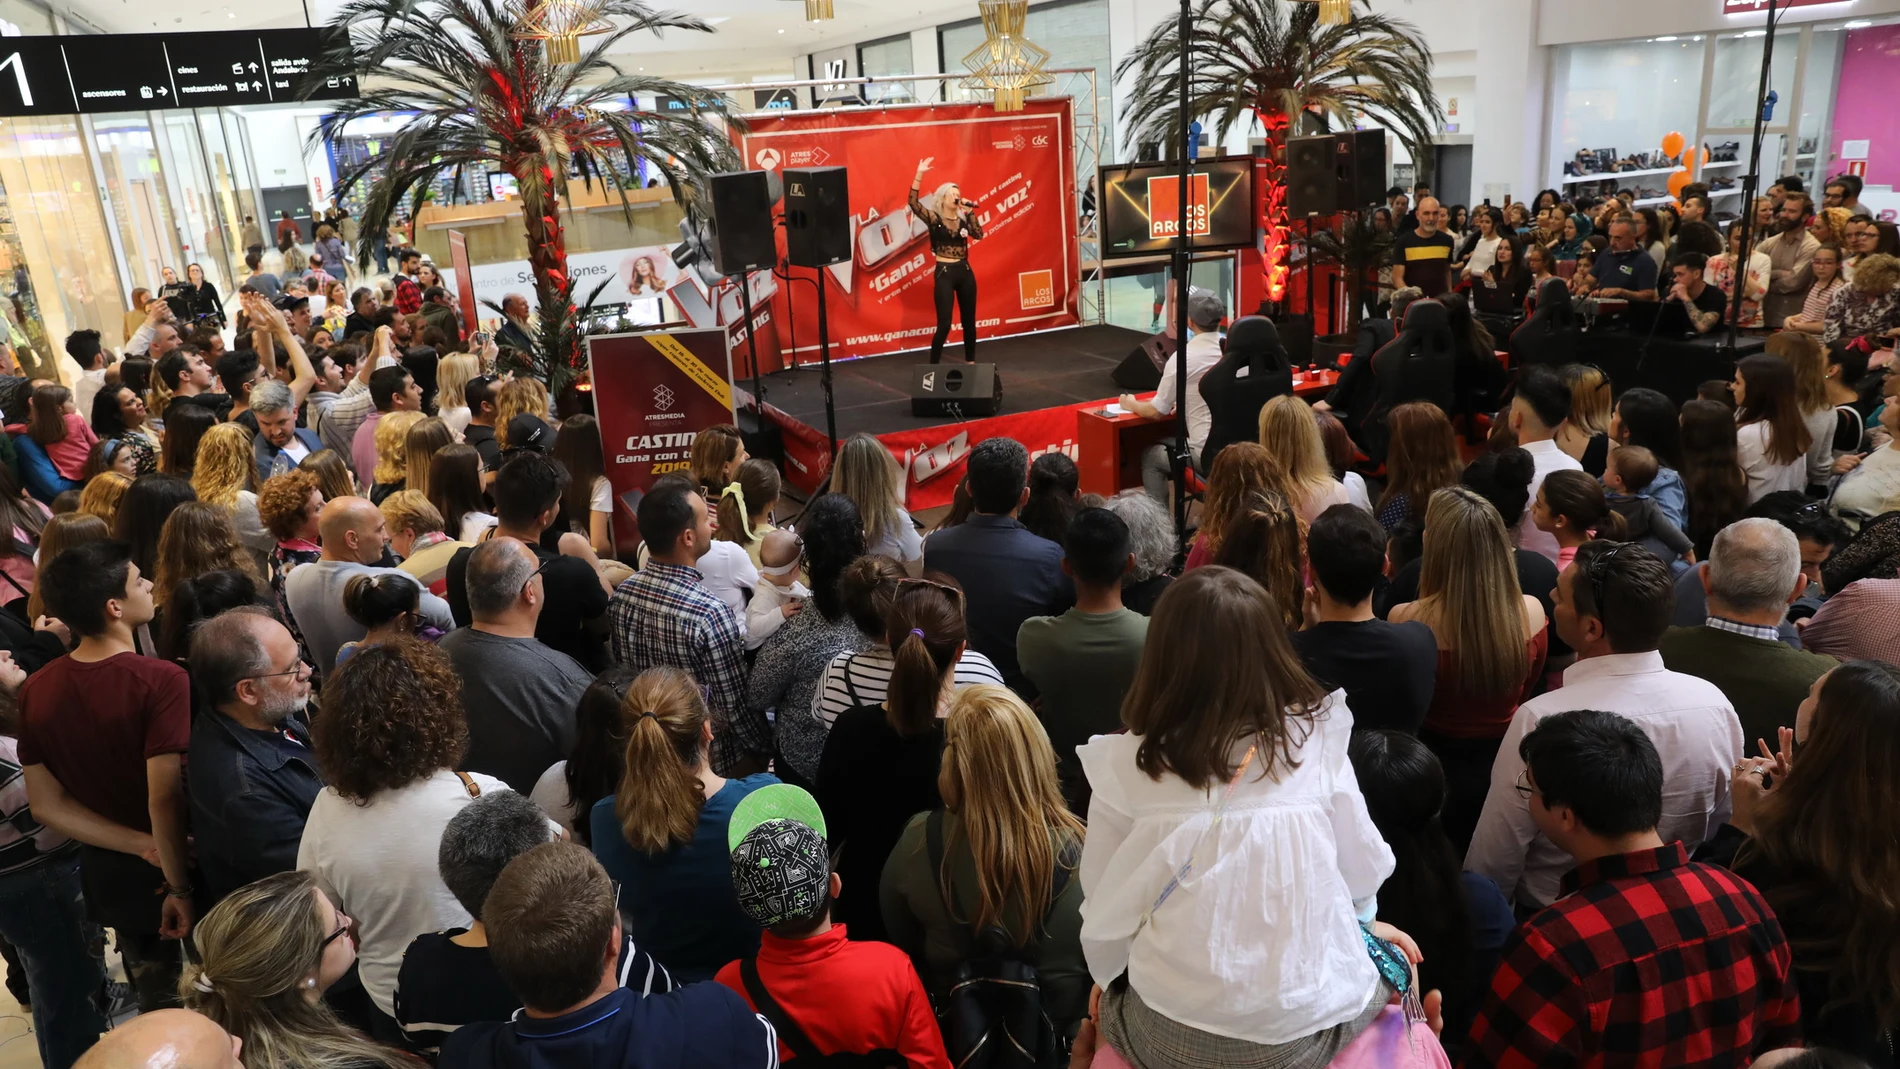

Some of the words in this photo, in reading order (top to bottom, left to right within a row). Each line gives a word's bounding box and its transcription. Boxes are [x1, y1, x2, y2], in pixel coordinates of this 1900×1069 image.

[270, 58, 292, 67] salida
[177, 66, 199, 74] cines
[181, 83, 228, 93] restauración
[82, 89, 127, 98] ascensores
[790, 157, 811, 165] player
[789, 183, 805, 196] LA
[979, 194, 989, 203] en
[990, 187, 998, 196] el
[998, 172, 1022, 190] casting
[857, 206, 880, 226] LA
[1186, 204, 1205, 218] OS
[878, 297, 884, 305] Y
[902, 281, 912, 291] en
[1035, 288, 1051, 297] LOS
[1024, 296, 1051, 306] ARCOS
[644, 412, 686, 421] ATRESMEDIA
[911, 443, 929, 456] LA
[615, 454, 651, 464] Gana
[654, 452, 679, 461] con
